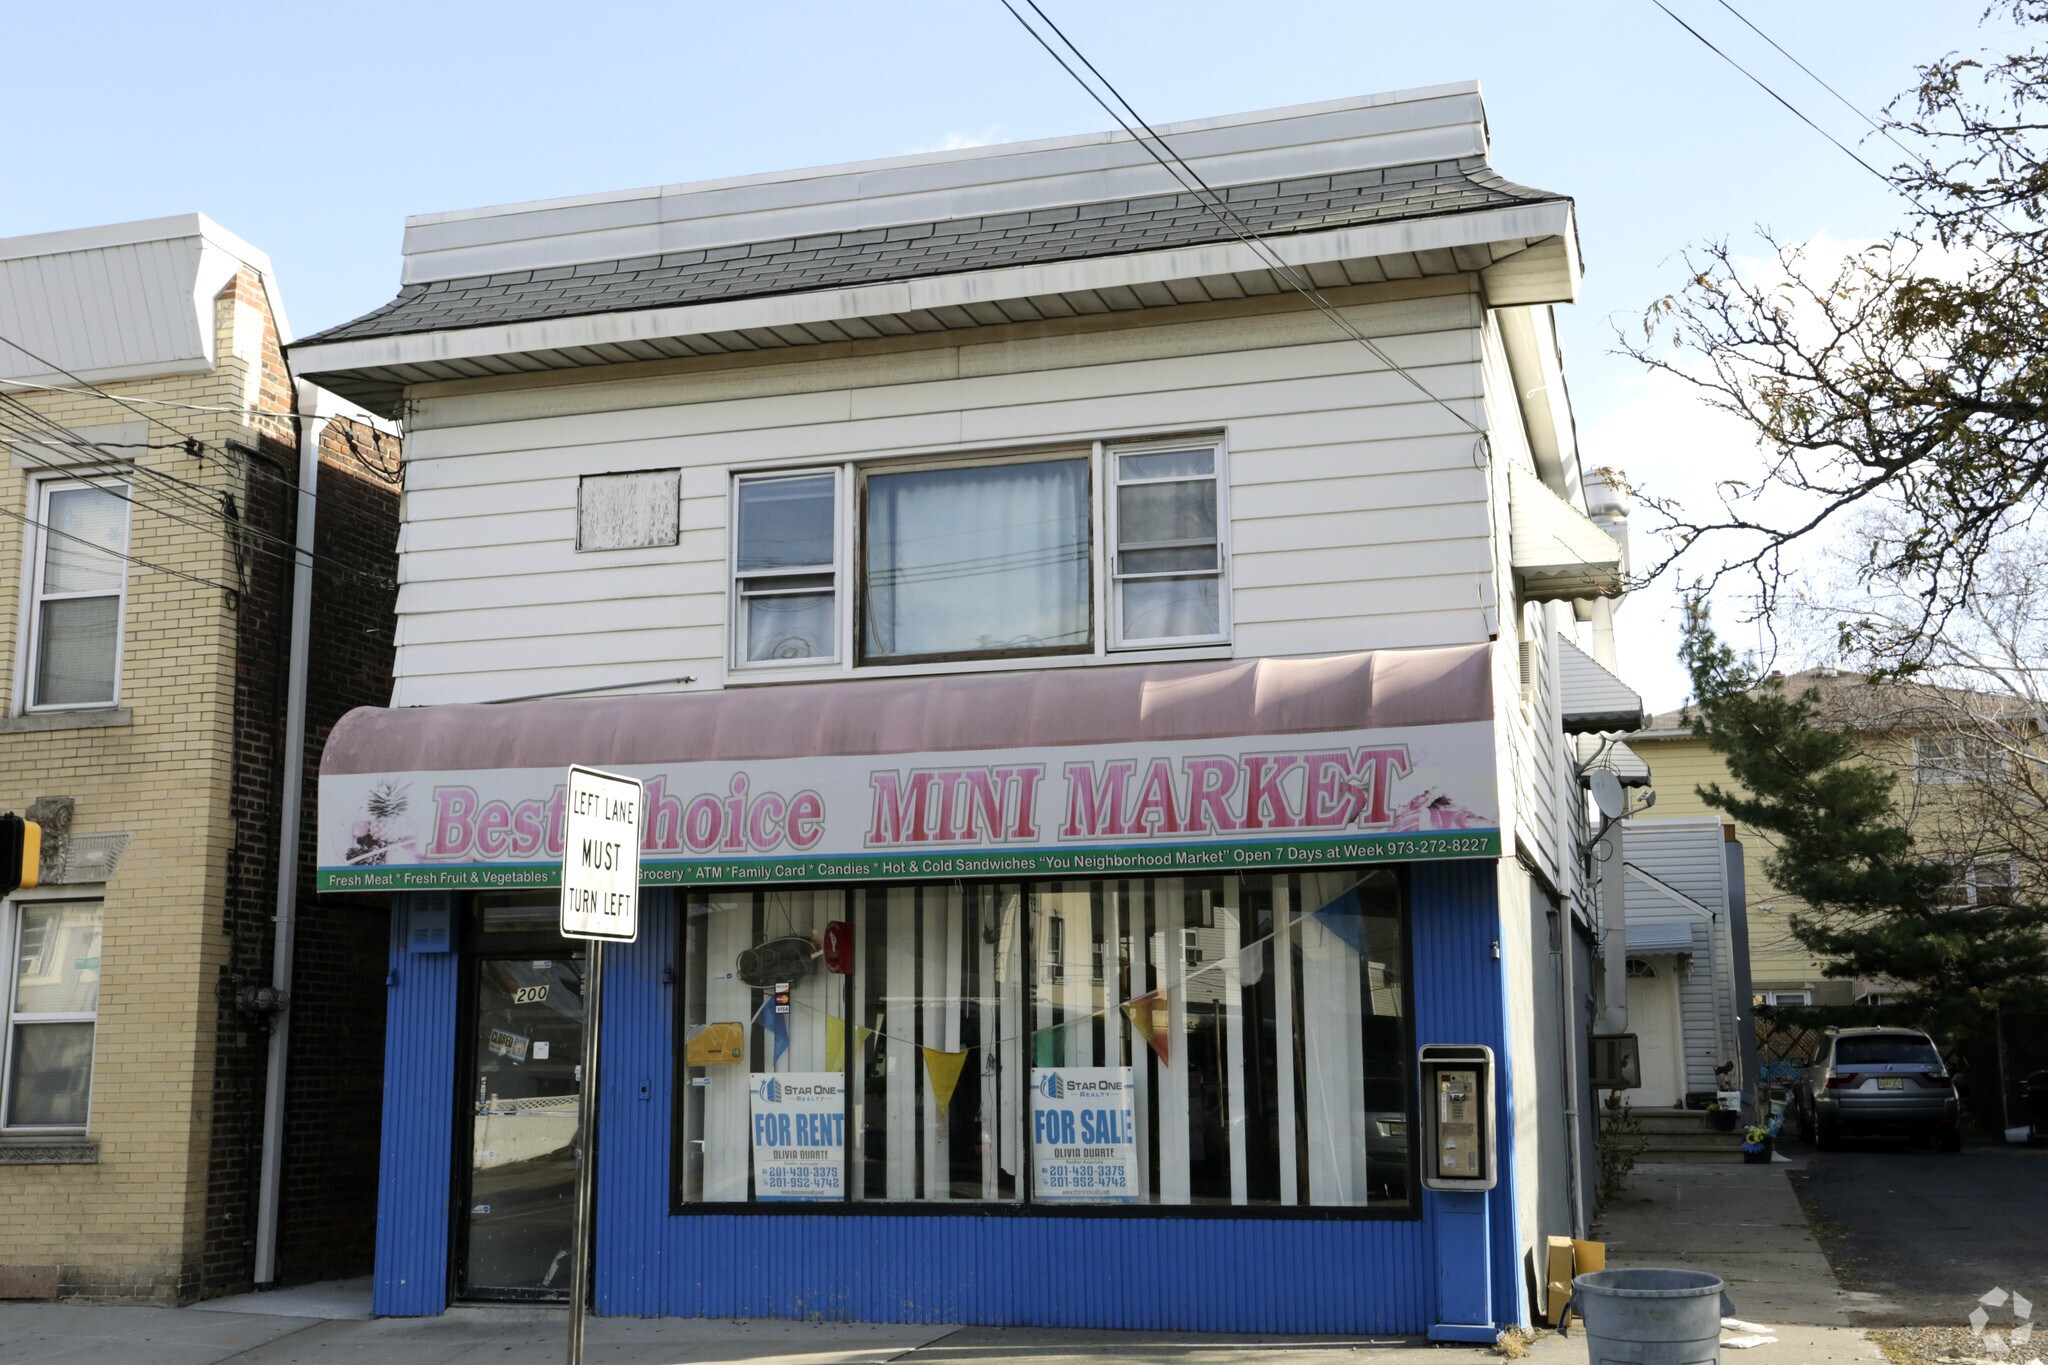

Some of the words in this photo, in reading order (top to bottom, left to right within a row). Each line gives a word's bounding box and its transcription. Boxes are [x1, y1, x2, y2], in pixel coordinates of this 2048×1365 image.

[864, 763, 1046, 848] MINI
[1058, 743, 1413, 841] MARKET
[425, 785, 567, 859] Best
[641, 771, 825, 854] hoice
[574, 790, 600, 818] LEFT
[605, 797, 634, 825] LANE
[581, 838, 621, 872] MUST
[696, 867, 722, 878] ATM
[776, 865, 806, 877] Card
[818, 863, 870, 875] Candies
[883, 862, 907, 873] Hot
[909, 861, 919, 873] &
[923, 860, 953, 872] Cold
[956, 858, 1036, 871] Sandwiches
[1074, 854, 1171, 870] Neighborhood
[1234, 849, 1271, 864] Open
[1276, 848, 1283, 859] 7
[1288, 846, 1323, 862] Days
[1327, 846, 1341, 858] at
[1344, 843, 1384, 857] Week
[1388, 838, 1489, 854] 973-272-8227
[329, 874, 361, 886] Fresh
[367, 873, 393, 885] Meat
[404, 872, 437, 884] Fresh
[440, 871, 467, 884] Fruit
[470, 871, 479, 883] &
[482, 870, 548, 886] Vegetables
[569, 888, 597, 914] TURN
[604, 892, 630, 917] LEFT
[517, 986, 547, 1003] 200
[491, 1030, 514, 1048] CLOSED
[784, 1085, 811, 1095] STAR
[813, 1085, 836, 1095] ONE
[1067, 1081, 1096, 1091] STAR
[1098, 1080, 1123, 1090] ONE
[755, 1113, 791, 1147] FOR
[796, 1113, 844, 1147] RENT
[1034, 1109, 1076, 1145] FOR
[1080, 1109, 1133, 1145] SALE
[773, 1150, 797, 1160] OLIVIA
[800, 1150, 828, 1160] DUARTE
[1054, 1148, 1081, 1158] OLIVIA
[1083, 1148, 1115, 1158] DUARTE
[769, 1167, 837, 1177] 201-430-3375
[1049, 1165, 1124, 1176] 201-430-3375
[770, 1178, 839, 1188] 201-952-4742
[1050, 1176, 1126, 1187] 201-952-4742
